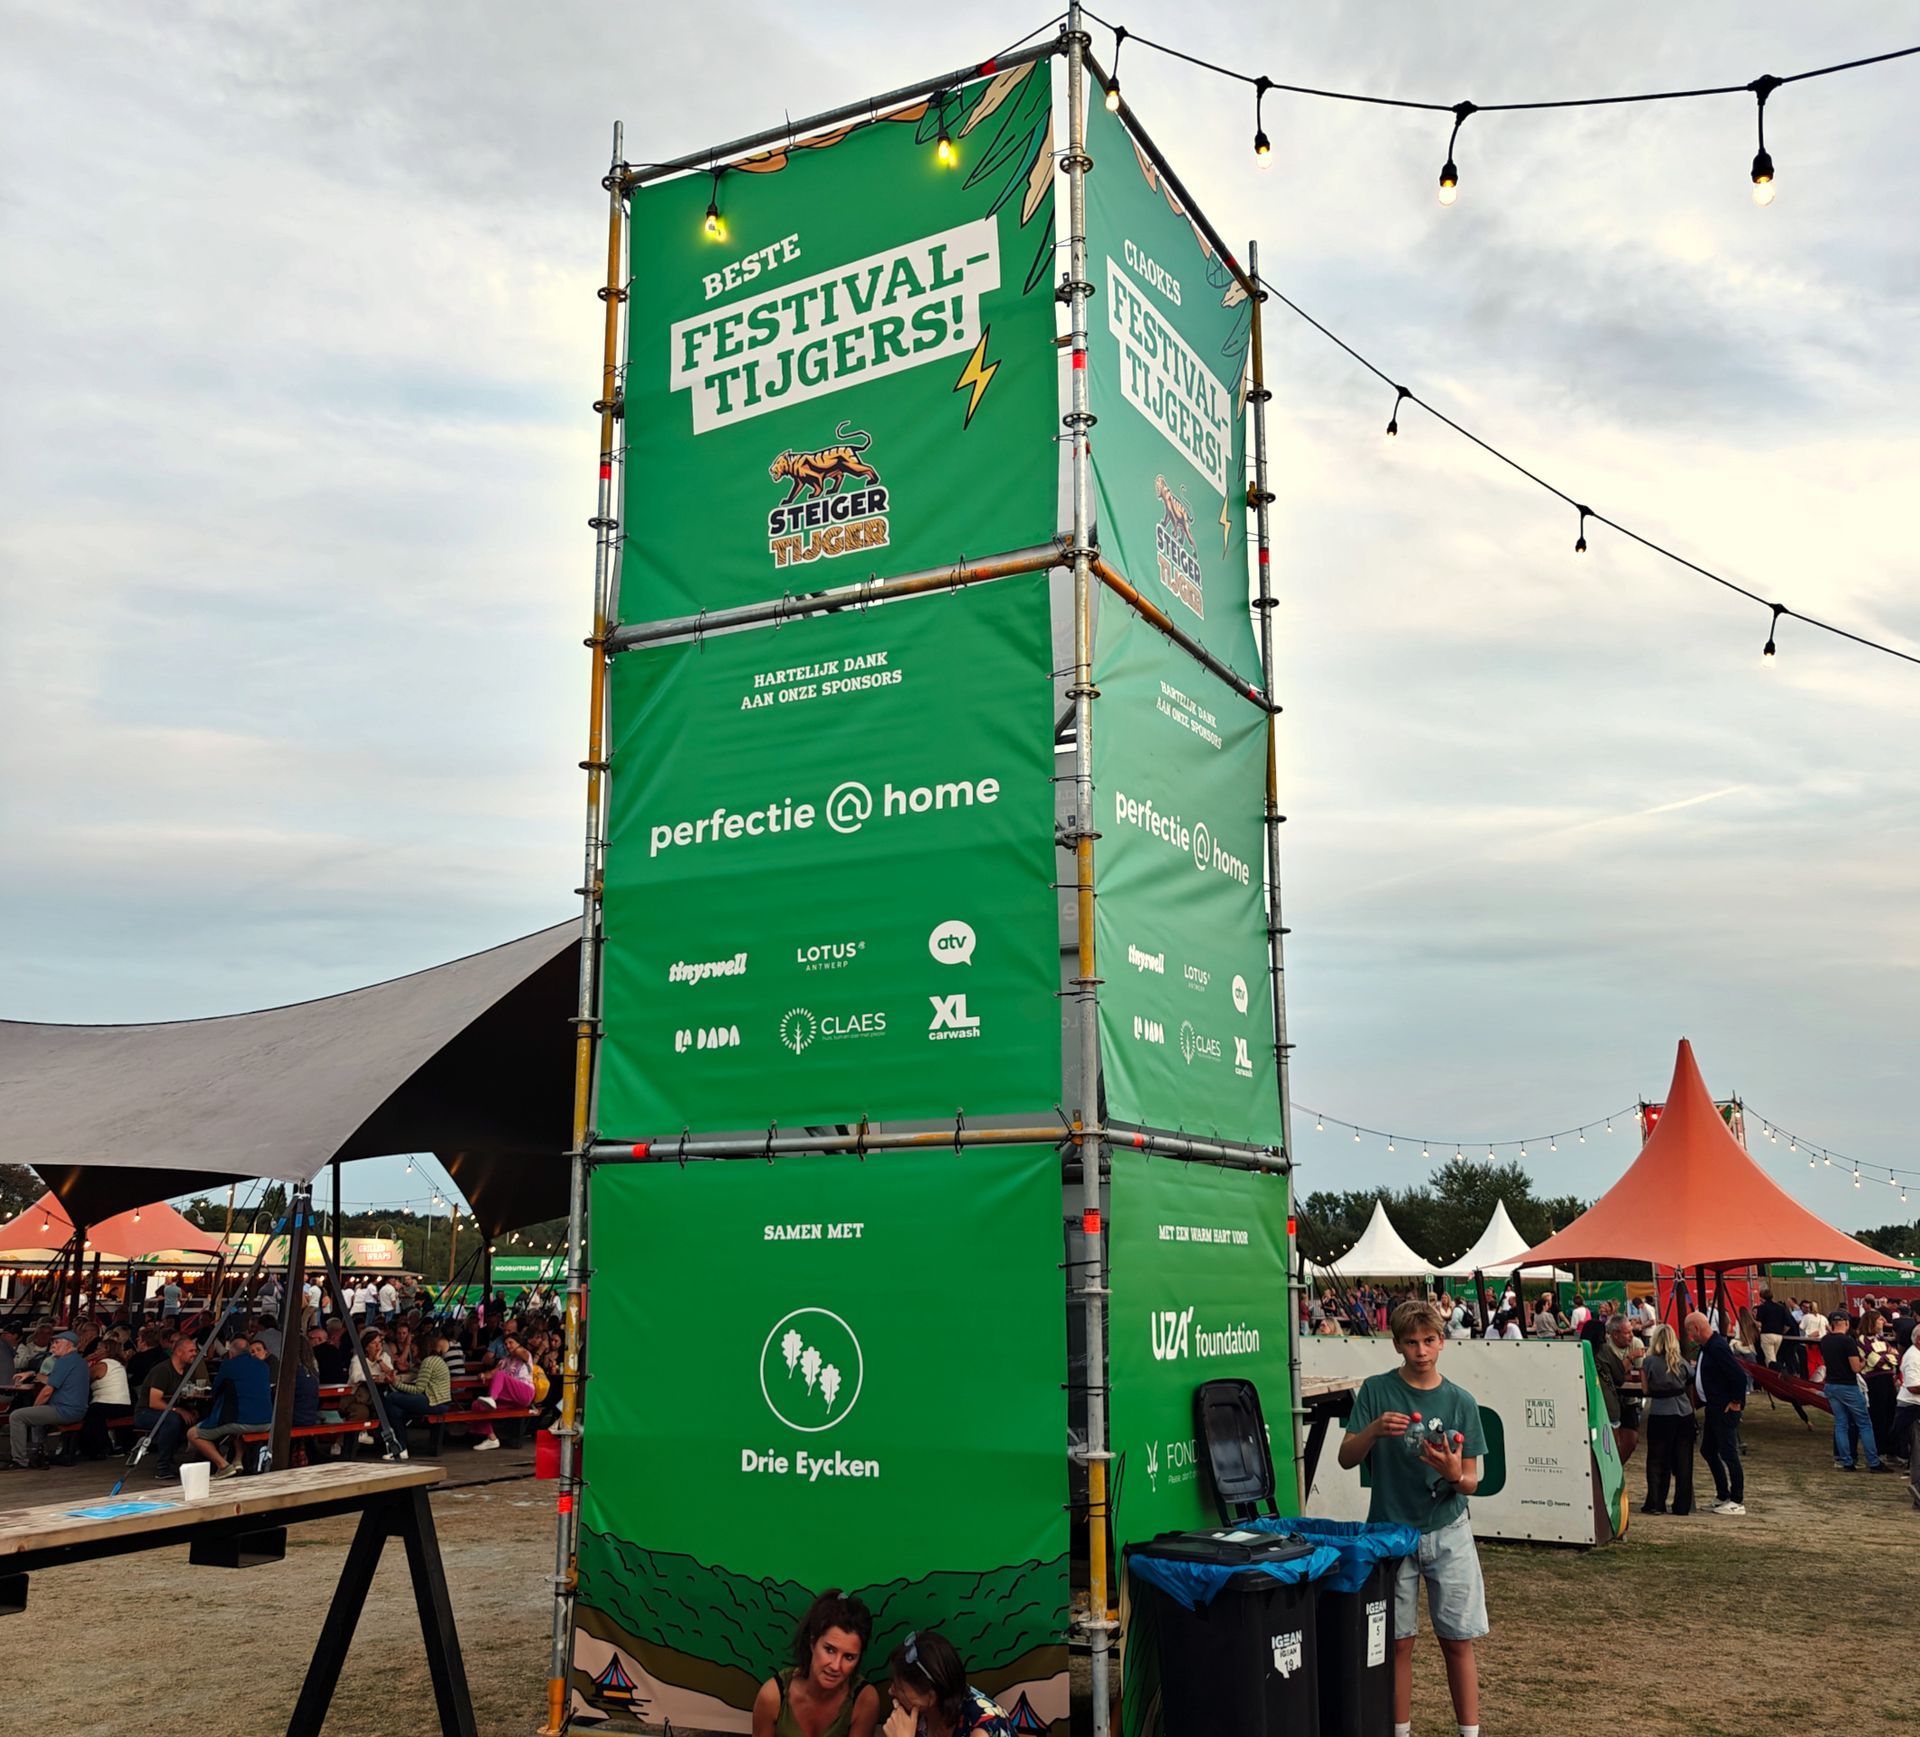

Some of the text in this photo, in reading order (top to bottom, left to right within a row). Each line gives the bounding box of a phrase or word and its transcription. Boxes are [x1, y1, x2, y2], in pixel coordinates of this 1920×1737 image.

[702, 233, 801, 300] BESTE
[1124, 238, 1181, 306] CIAOKES
[681, 243, 990, 372] FESTIVAL-
[704, 294, 965, 415] TIJGERS!
[1112, 276, 1229, 432] FESTIVAL-
[1125, 343, 1222, 483] TIJGERS!
[769, 487, 888, 535] STEIGER
[770, 517, 889, 567] TIJGER
[1156, 525, 1202, 587] STEIGER
[753, 651, 888, 688] HARTELIJK DANK
[741, 669, 903, 710] AAN ONZE SPONSORS
[1159, 680, 1217, 728] HARTELIJK DANK
[1156, 696, 1223, 750] AAN ONZE SPONSORS
[649, 797, 815, 858] perfectie
[883, 777, 1000, 817] home
[1115, 790, 1190, 851] perfectie
[1213, 837, 1250, 886] home
[937, 933, 967, 950] atv
[1128, 943, 1165, 975] tinyswell
[668, 952, 748, 986] tinyswell
[805, 960, 849, 972] ANTWERP
[821, 1012, 886, 1035] CLAES
[928, 993, 980, 1030] XL
[928, 1026, 980, 1040] carwash
[1195, 1035, 1221, 1057] CLAES
[1234, 1035, 1253, 1069] XL
[763, 1223, 864, 1241] SAMEN MET
[1158, 1224, 1249, 1245] MET EEN WARM HART VOOR
[1195, 1322, 1260, 1358] foundation
[1527, 1408, 1554, 1427] PLUS
[741, 1448, 880, 1482] Drie Eycken
[1528, 1457, 1558, 1465] DELEN
[1366, 1599, 1387, 1615] IGEAN
[1271, 1629, 1303, 1650] IGEAN
[1284, 1659, 1294, 1671] 19
